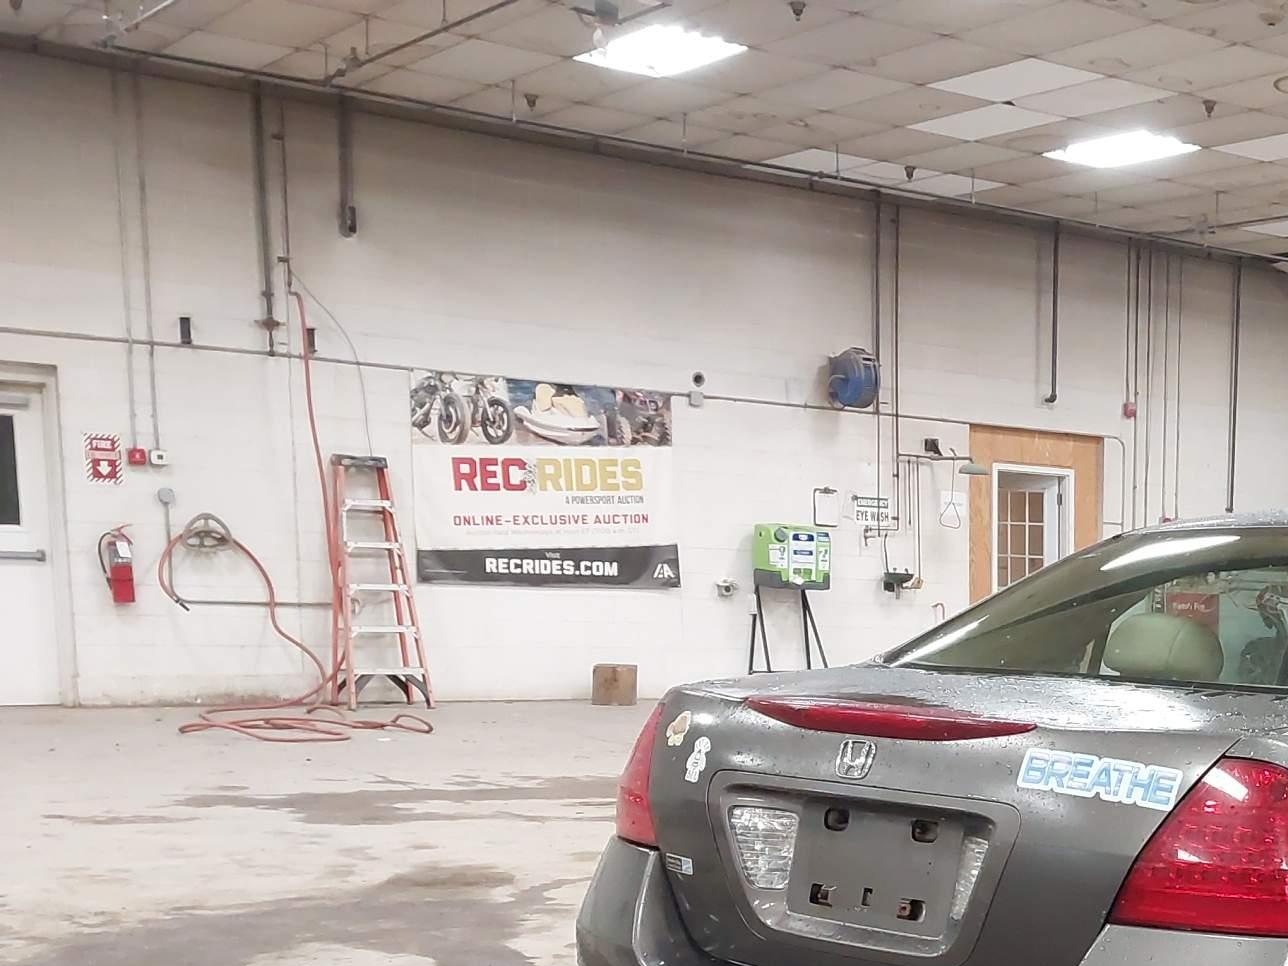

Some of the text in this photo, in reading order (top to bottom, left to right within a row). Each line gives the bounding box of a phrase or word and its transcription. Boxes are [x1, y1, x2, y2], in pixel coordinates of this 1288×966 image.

[451, 457, 643, 492] REC RIDES
[617, 495, 644, 504] AUCTION
[453, 513, 649, 526] ONLINE-EXCLUSIVE AUCTION
[856, 509, 869, 521] EYE
[485, 557, 618, 577] RECRIDES.COM
[1021, 751, 1178, 806] BREATHE
